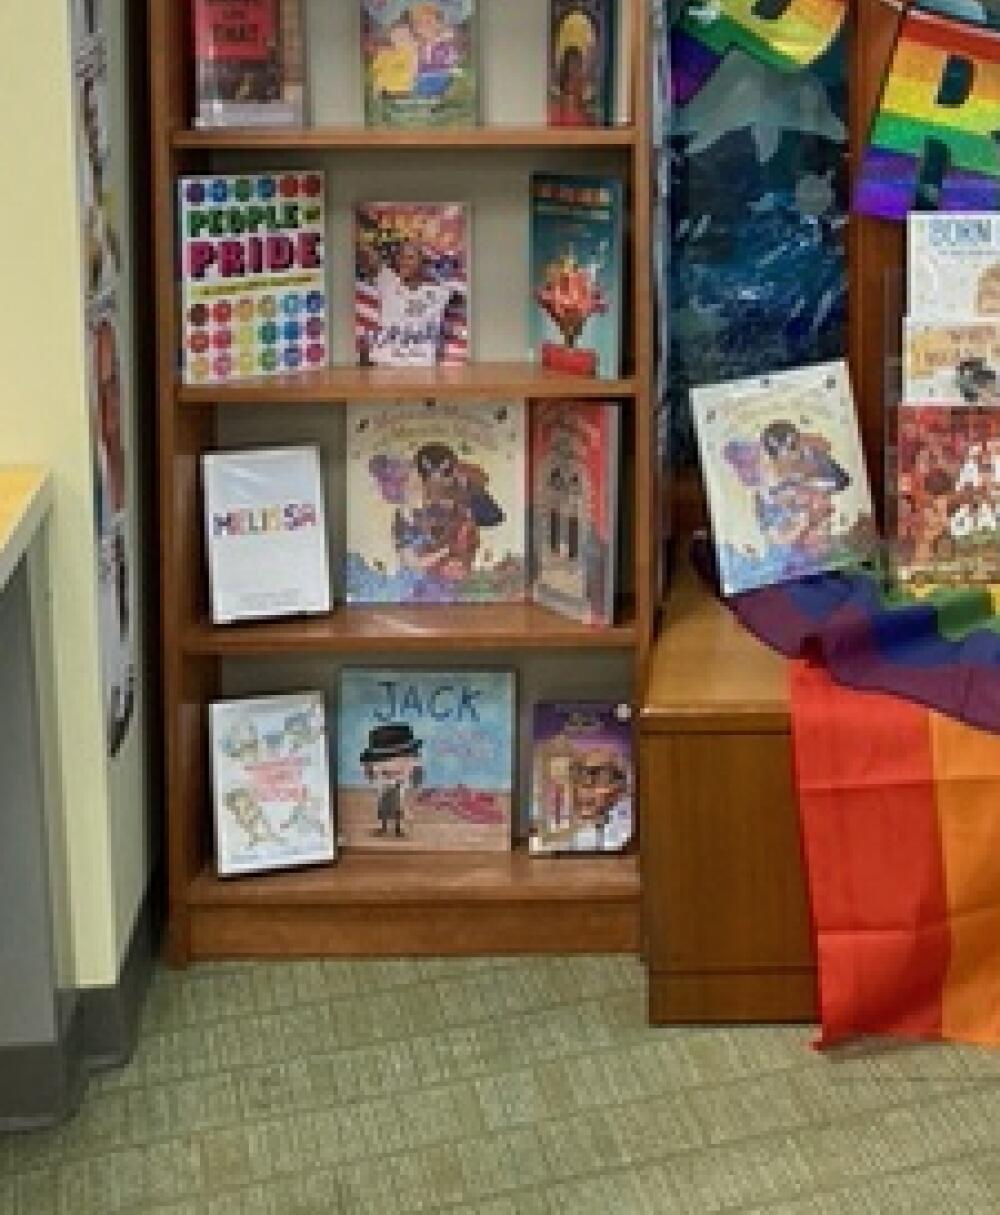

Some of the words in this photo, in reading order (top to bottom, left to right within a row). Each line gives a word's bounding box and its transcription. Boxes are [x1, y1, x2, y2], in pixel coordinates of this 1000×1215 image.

[187, 205, 300, 237] PEOPLE
[187, 232, 322, 278] PRIDE
[212, 502, 318, 536] MELISSA
[370, 680, 486, 722] JACK
